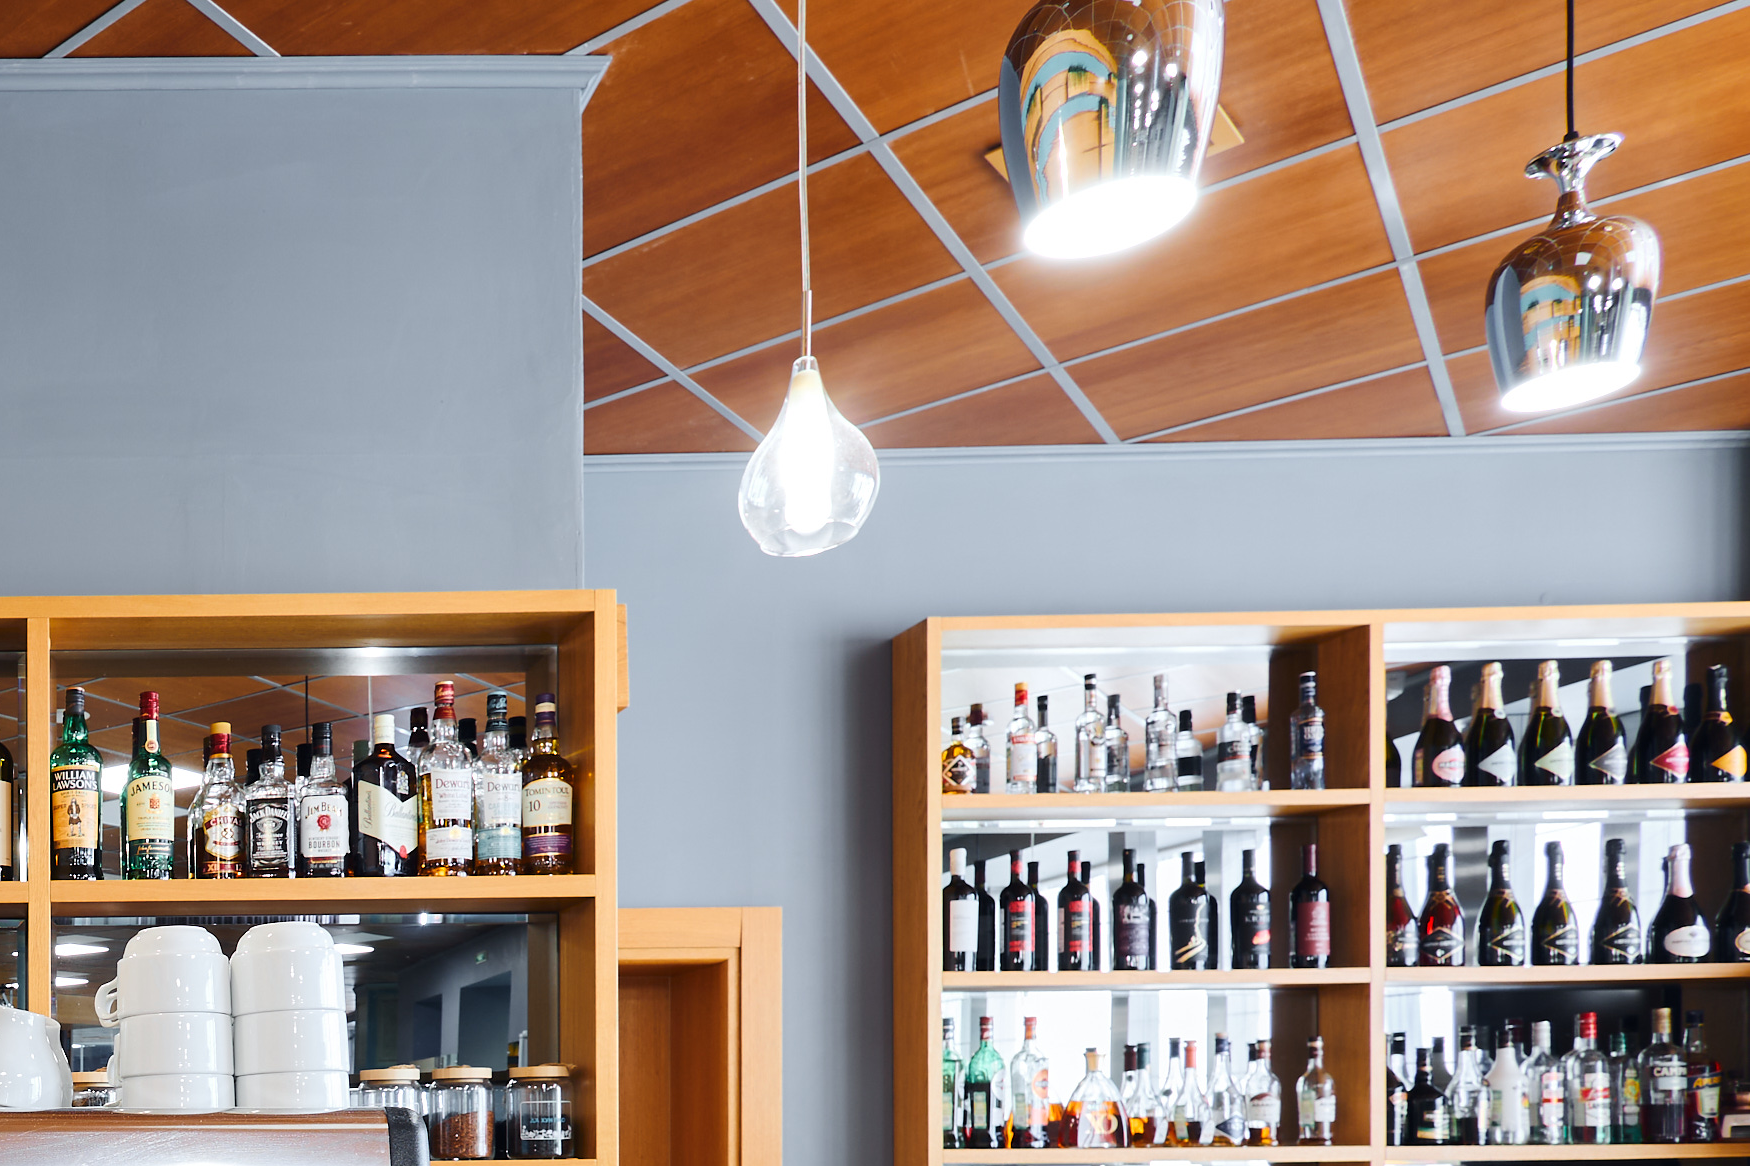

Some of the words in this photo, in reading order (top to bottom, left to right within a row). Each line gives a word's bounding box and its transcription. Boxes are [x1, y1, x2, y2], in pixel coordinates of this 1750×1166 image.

[54, 770, 95, 781] WILLIAM
[305, 804, 319, 819] JIM
[308, 841, 340, 849] BOURBON
